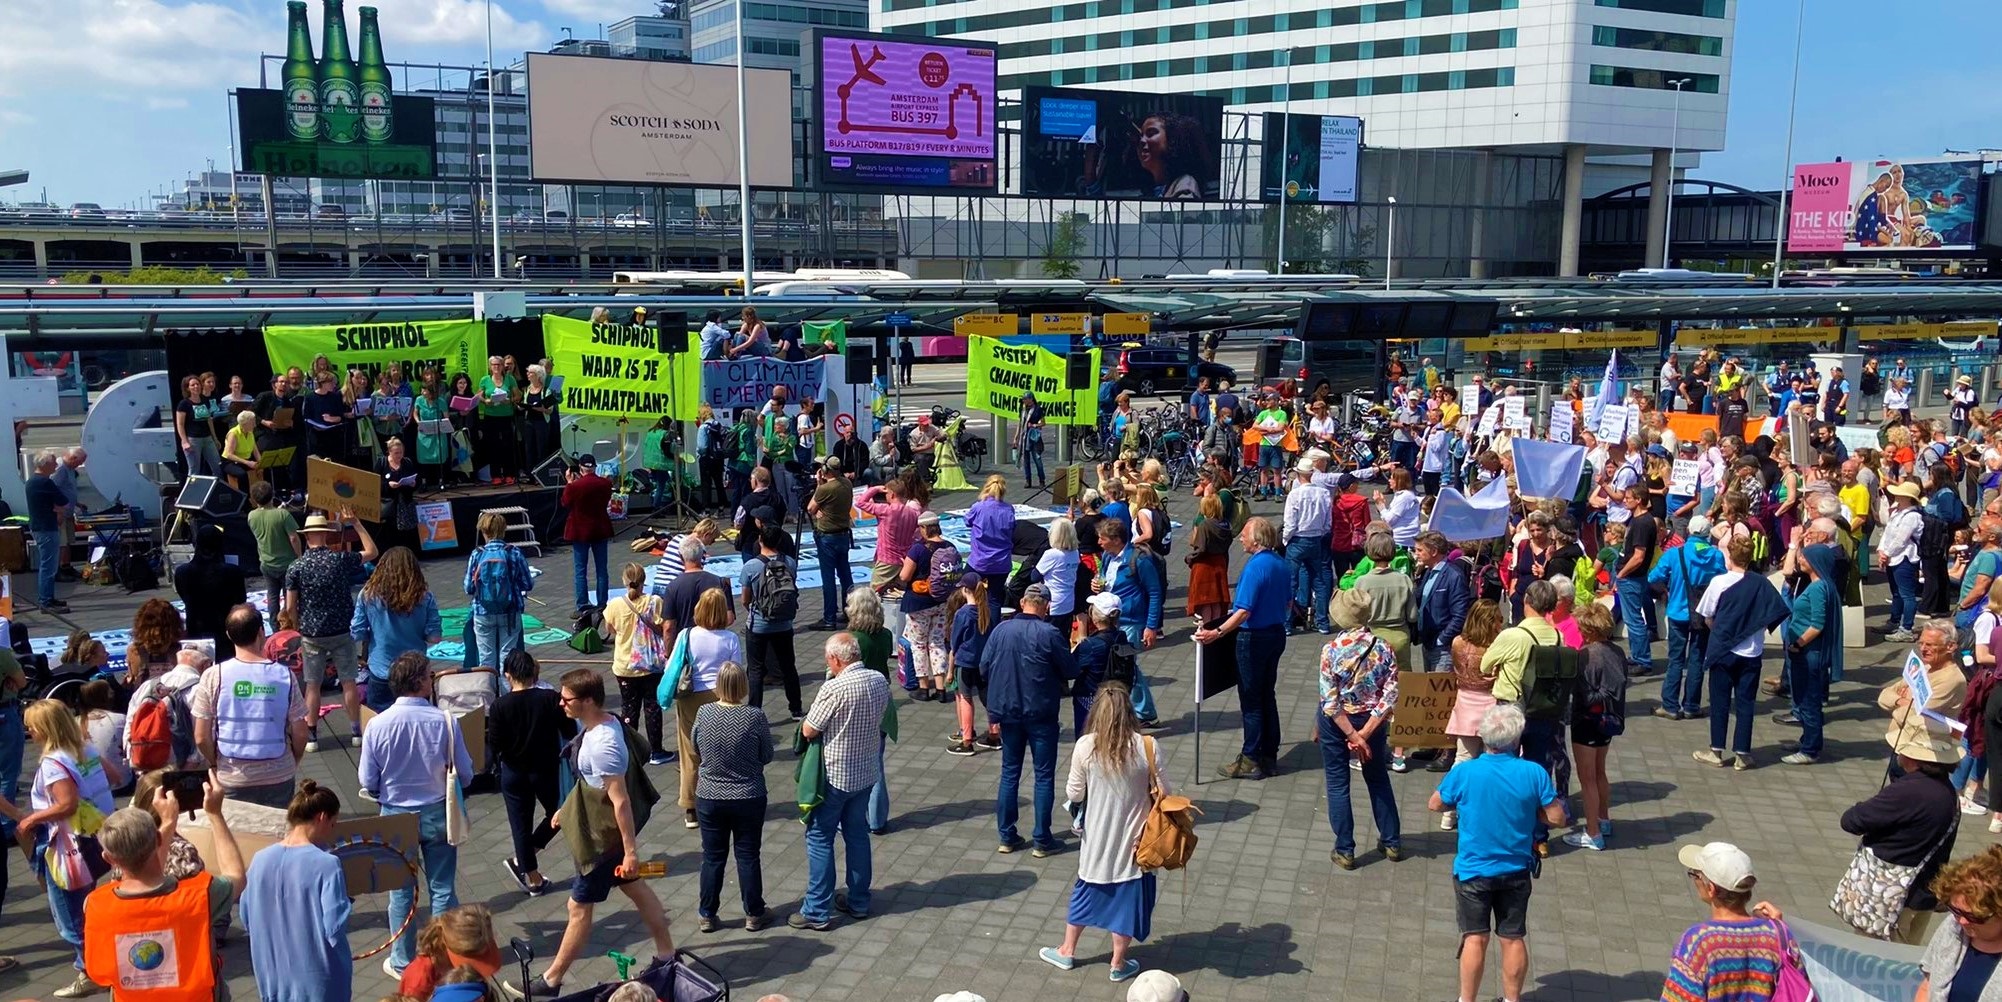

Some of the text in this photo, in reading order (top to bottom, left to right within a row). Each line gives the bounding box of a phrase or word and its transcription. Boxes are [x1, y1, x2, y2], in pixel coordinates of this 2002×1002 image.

[891, 94, 938, 103] AMSTERDAM
[610, 115, 667, 128] SCOTCH
[684, 119, 720, 131] SODA
[891, 111, 938, 123] BUS 397
[1322, 119, 1339, 127] RELAX
[1329, 127, 1357, 136] THAILAND
[829, 139, 845, 148] BUS
[846, 140, 888, 150] PLATFORM
[888, 141, 920, 150] B17/B19
[926, 144, 949, 152] EVERY
[957, 145, 989, 154] MINUTES
[856, 164, 877, 172] Always
[878, 165, 894, 173] bring
[1799, 174, 1839, 187] Moco
[1794, 211, 1822, 228] THE
[993, 316, 1004, 324] BC
[336, 325, 429, 351] SCHIPHOL
[591, 322, 656, 349] SCHIPHOL
[992, 345, 1037, 366] SYSTEM
[581, 354, 659, 381] WAAR IS JE
[728, 363, 816, 382] CLIMATE
[990, 366, 1058, 395] CHANGE NOT
[567, 386, 669, 414] KLIMAATPLAN?
